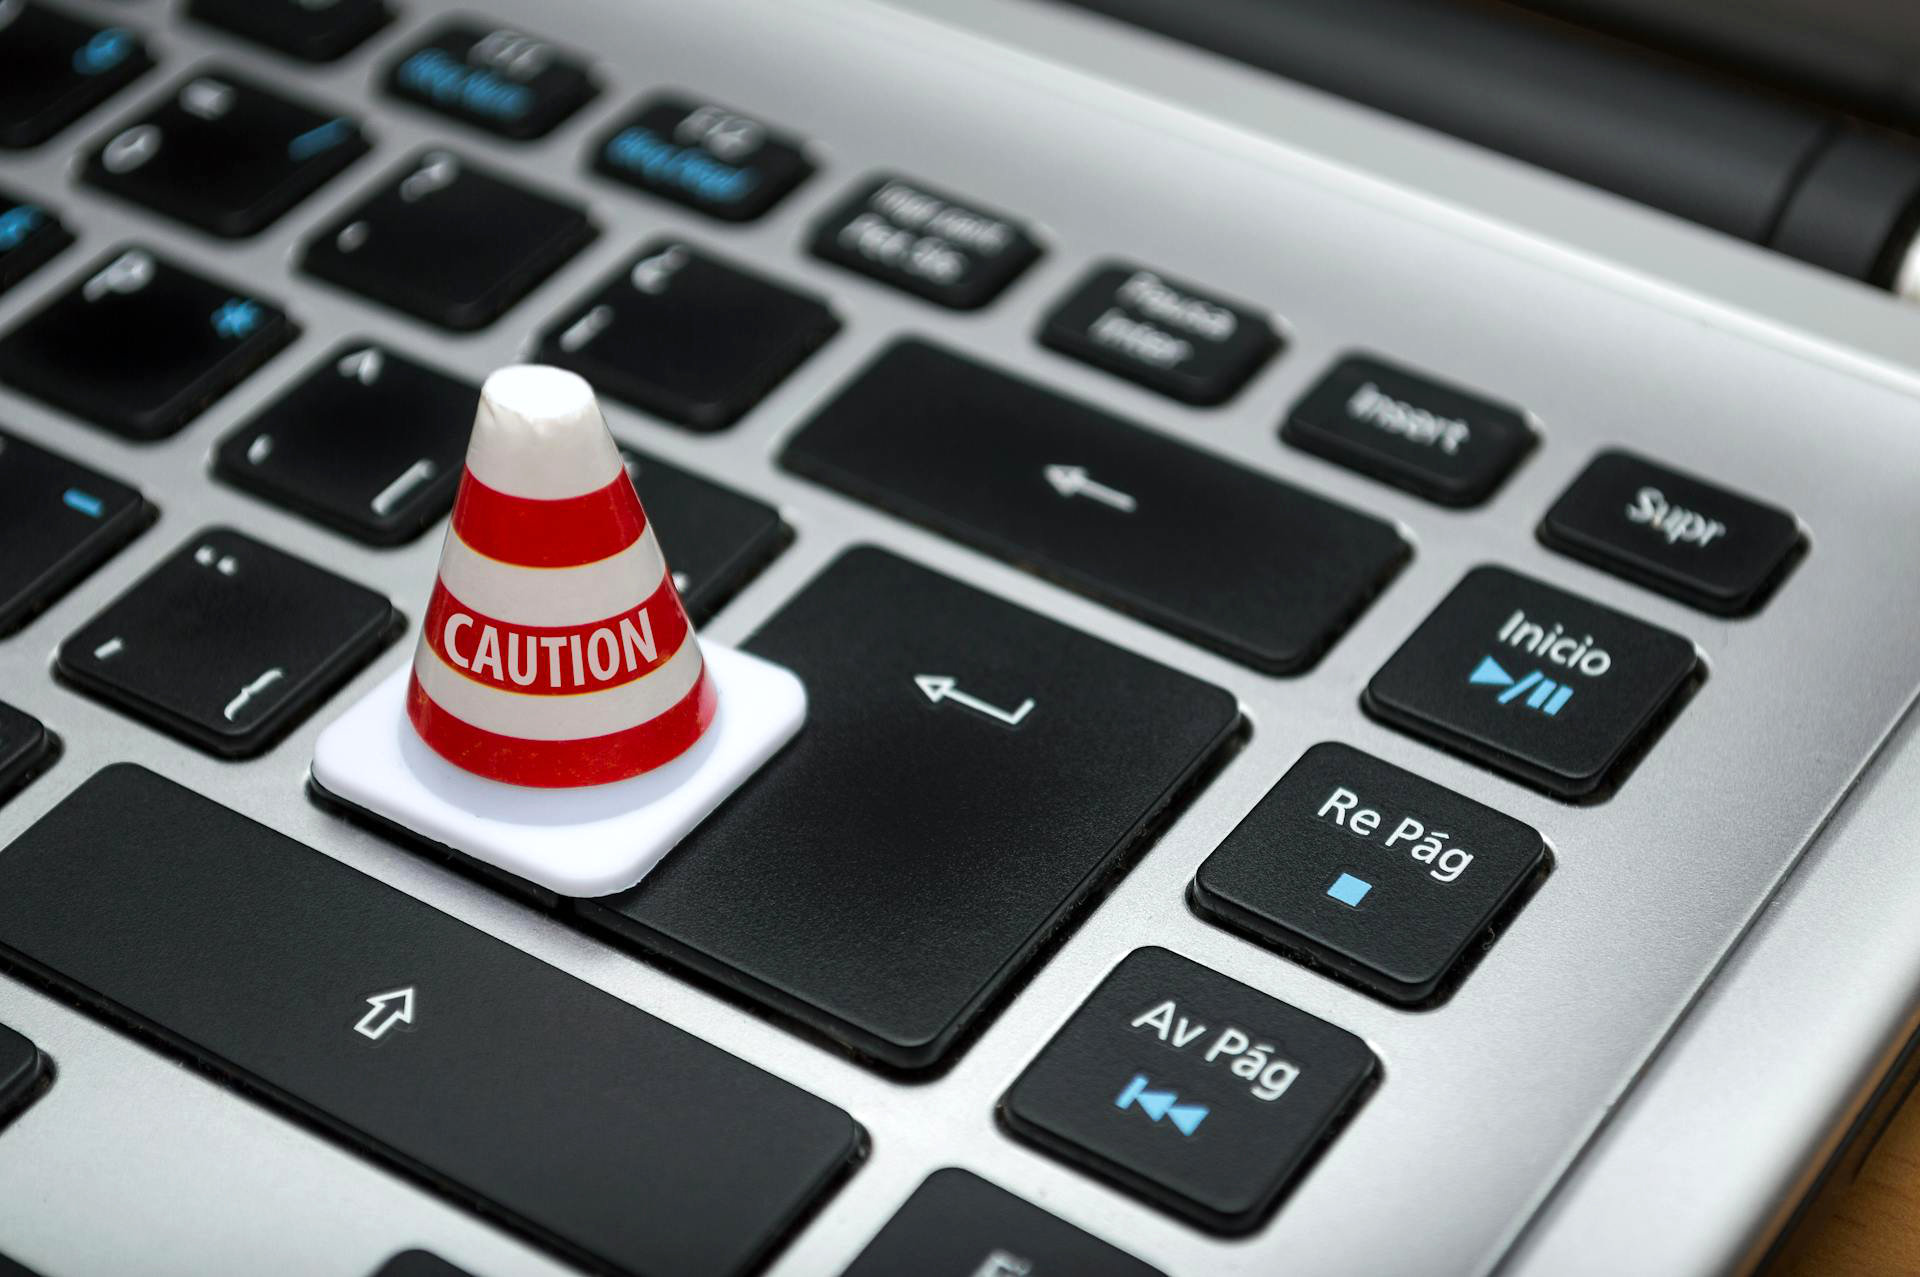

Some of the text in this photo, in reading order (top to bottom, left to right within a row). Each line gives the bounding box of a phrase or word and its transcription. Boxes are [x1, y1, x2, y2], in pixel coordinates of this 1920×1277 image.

[1347, 381, 1471, 455] Insert
[1625, 486, 1727, 547] Supr
[443, 607, 658, 688] CAUTION
[1498, 608, 1612, 677] Inicio
[1317, 786, 1475, 882] Re Pág
[1130, 1000, 1301, 1102] Av Pág
